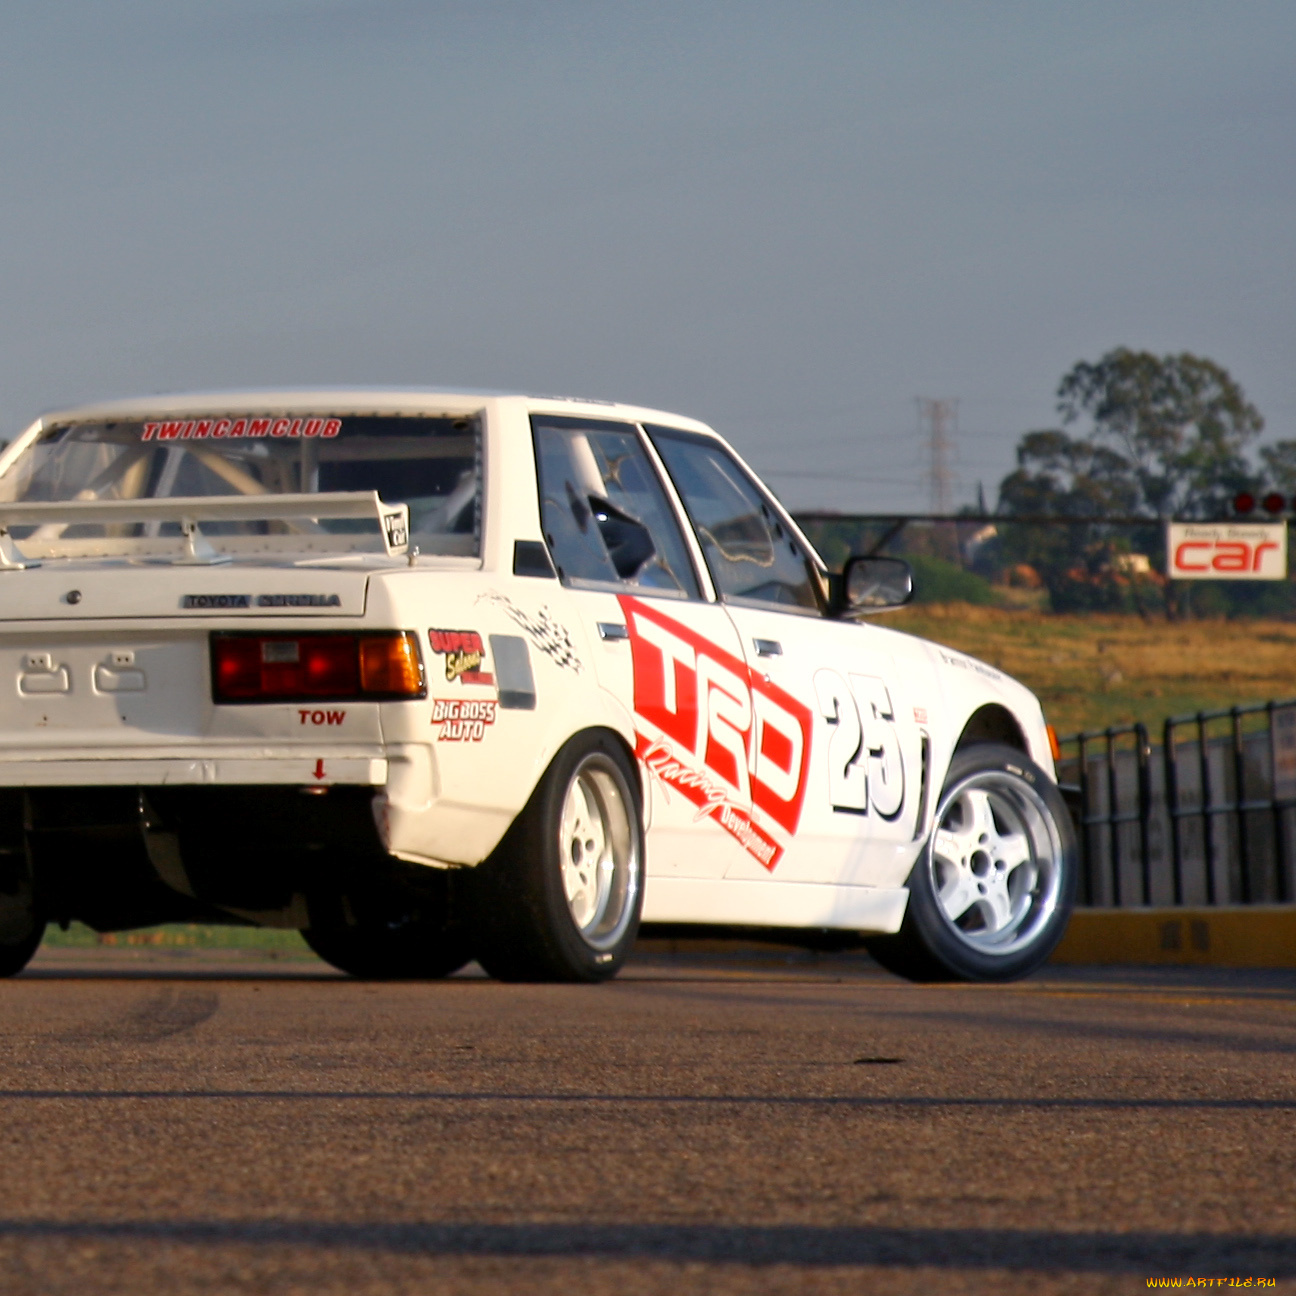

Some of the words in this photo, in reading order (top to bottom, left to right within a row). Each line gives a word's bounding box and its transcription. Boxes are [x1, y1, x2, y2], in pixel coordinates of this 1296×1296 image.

[142, 418, 342, 441] TWINCAMCLUB
[1174, 541, 1279, 572] car
[187, 595, 249, 608] TOYOTA
[429, 628, 485, 657] SUPER
[298, 710, 346, 725] TOW
[459, 701, 496, 723] BOSS
[626, 604, 807, 810] TRD
[439, 720, 484, 741] AUTO
[813, 668, 906, 822] 25
[641, 735, 746, 822] Racing
